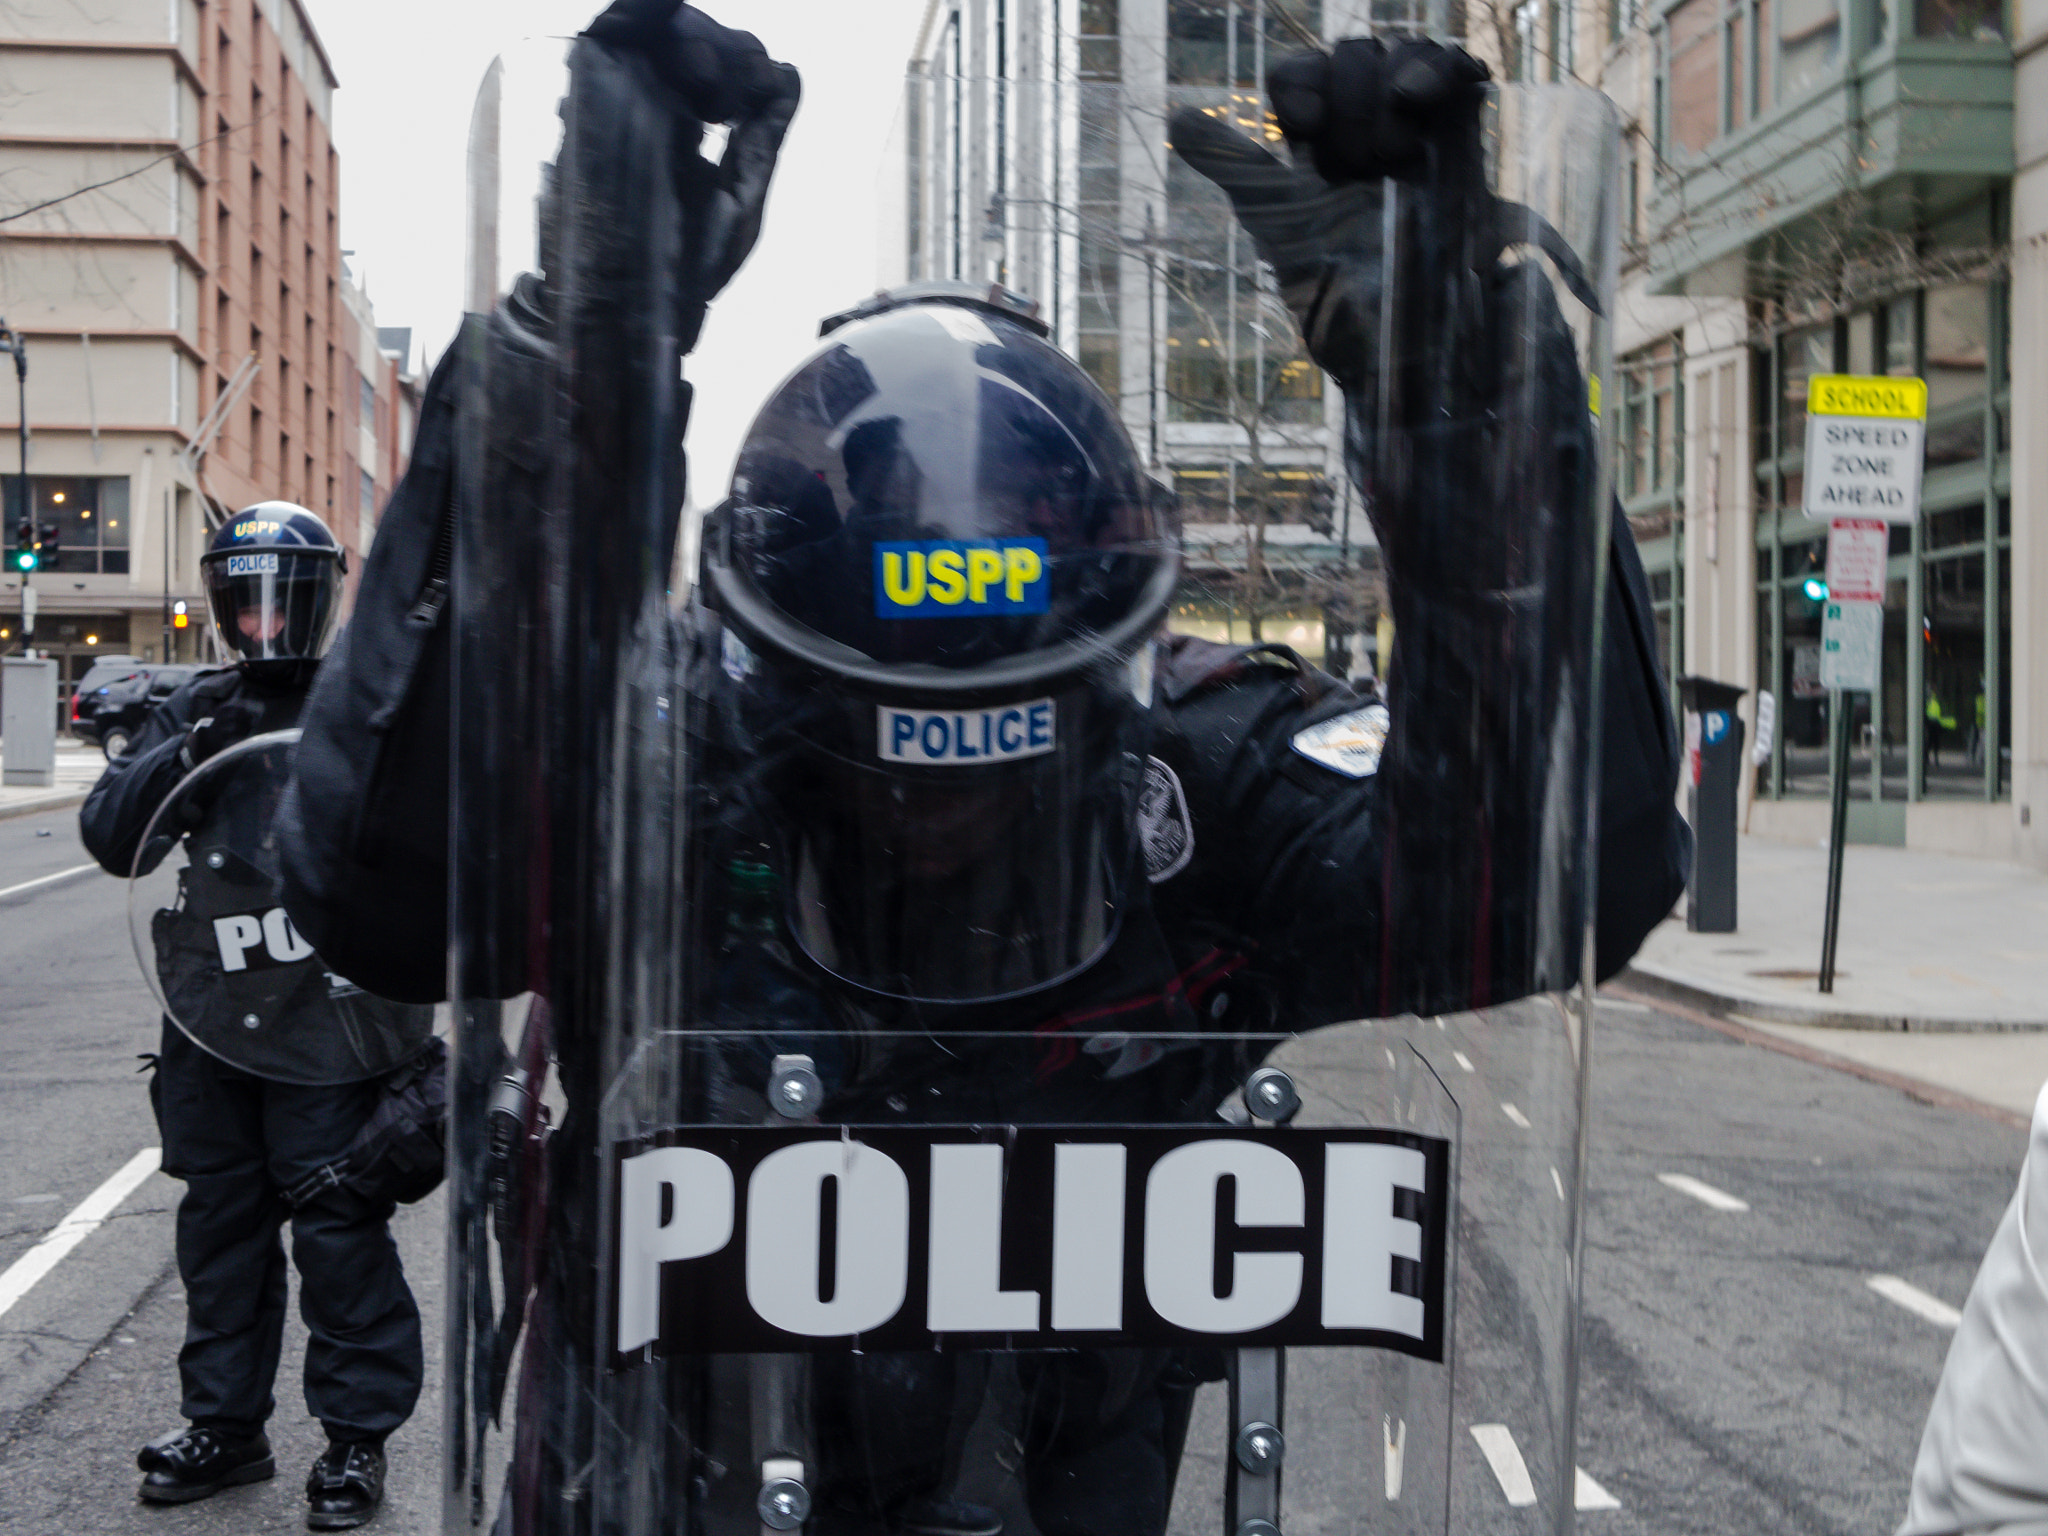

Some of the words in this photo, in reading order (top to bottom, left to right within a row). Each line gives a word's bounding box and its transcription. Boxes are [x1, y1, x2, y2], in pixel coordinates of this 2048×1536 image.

[1822, 385, 1911, 412] SCHOOL
[1825, 424, 1909, 447] SPEED
[1832, 455, 1896, 477] ZONE
[1822, 484, 1904, 506] AHEAD
[234, 520, 280, 537] USPP
[230, 554, 276, 572] POLICE
[882, 547, 1043, 606] USPP
[892, 704, 1050, 758] POLICE
[619, 1139, 1427, 1353] POLICE
